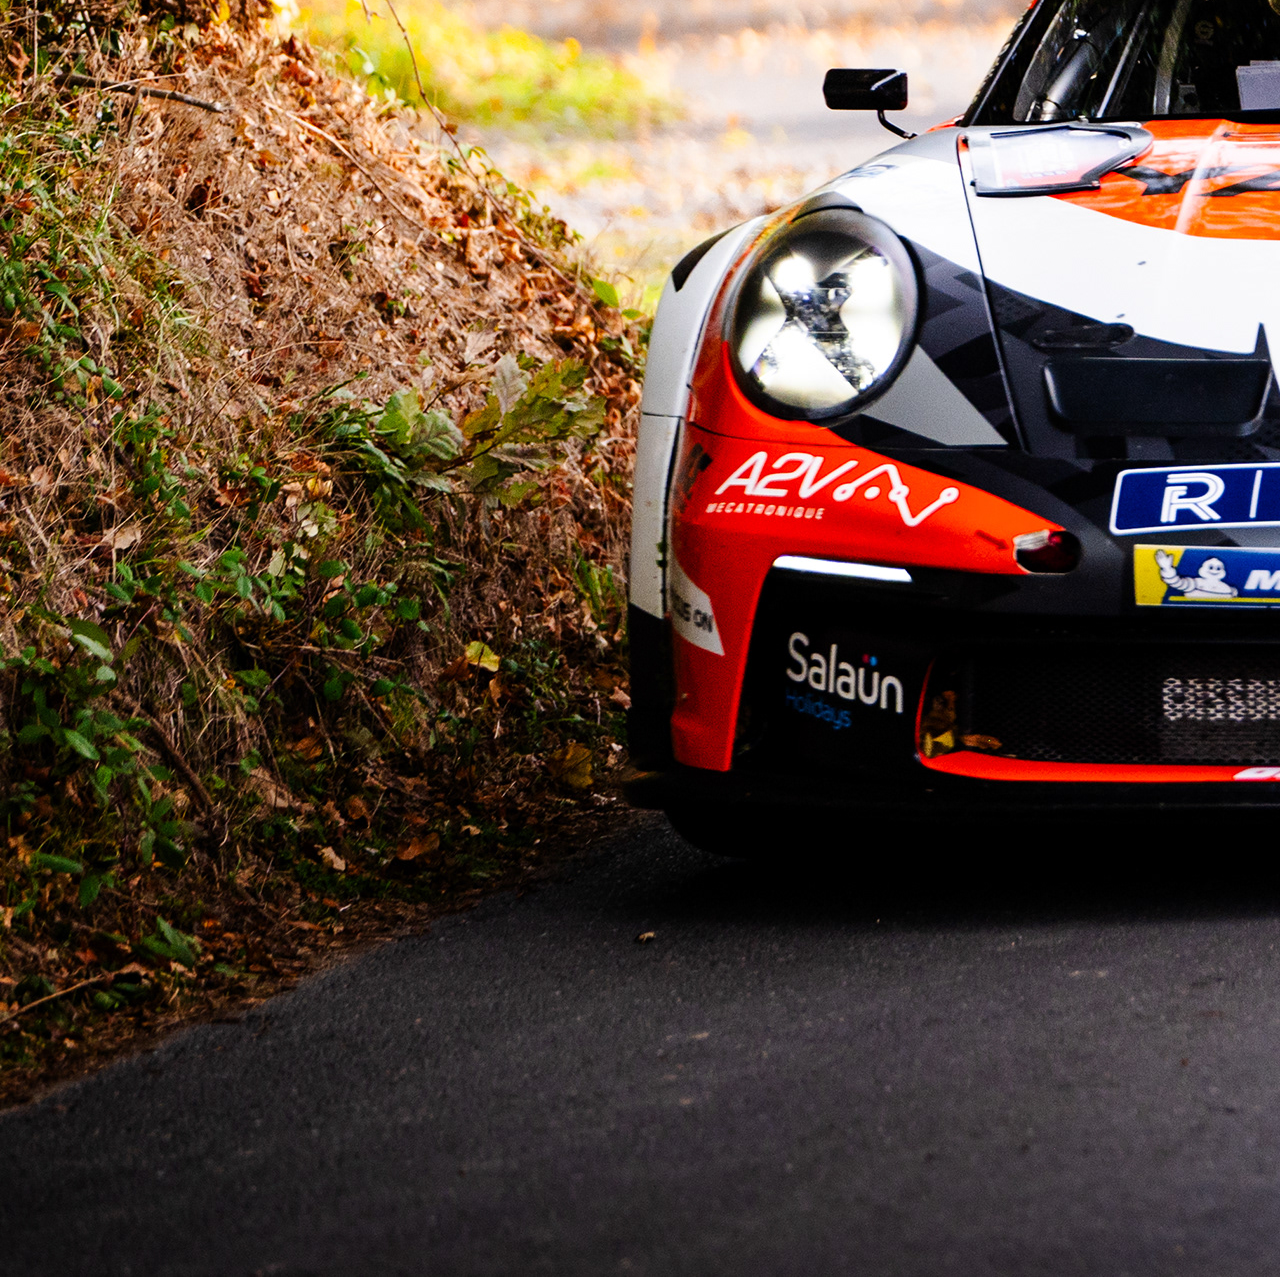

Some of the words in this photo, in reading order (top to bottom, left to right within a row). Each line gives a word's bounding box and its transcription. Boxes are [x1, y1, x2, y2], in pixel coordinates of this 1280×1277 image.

[714, 451, 858, 500] A2V
[706, 502, 826, 521] MECATRONIQUE
[785, 631, 904, 714] Salaün
[785, 689, 853, 730] Holidays
